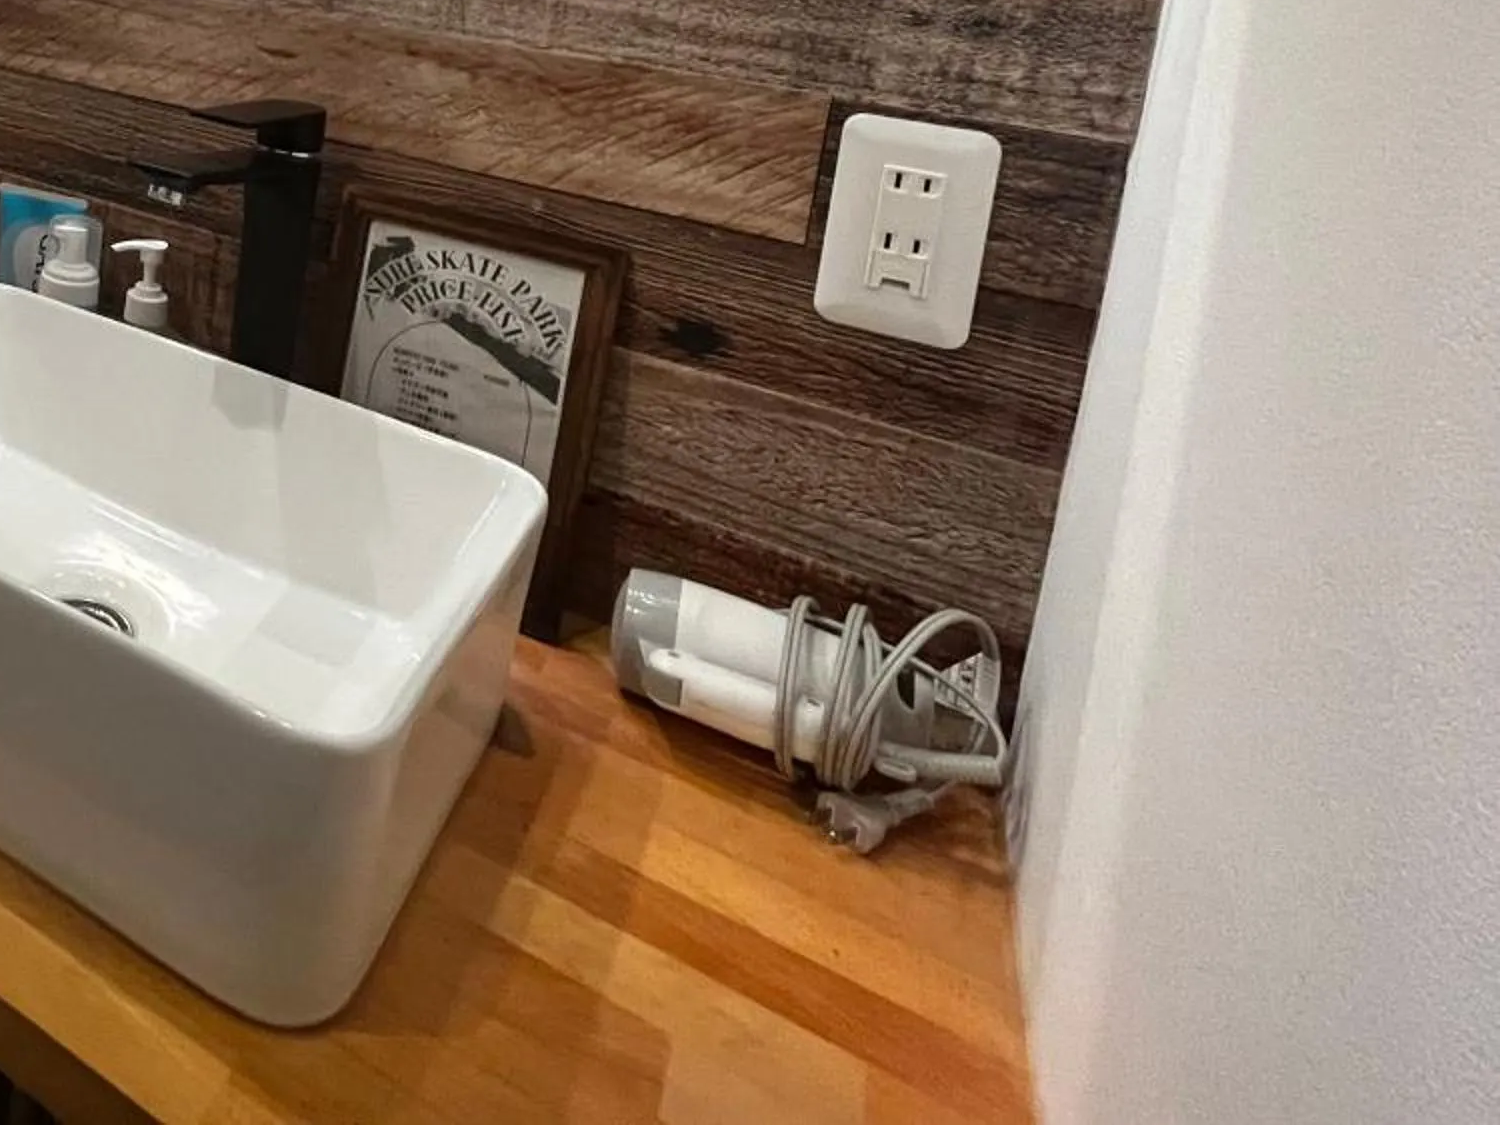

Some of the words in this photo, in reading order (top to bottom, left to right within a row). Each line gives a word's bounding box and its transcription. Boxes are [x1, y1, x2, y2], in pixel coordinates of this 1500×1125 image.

[400, 279, 474, 314] PRICE
[478, 292, 526, 342] LIST
[426, 250, 510, 286] SKATE
[510, 278, 566, 354] PARK
